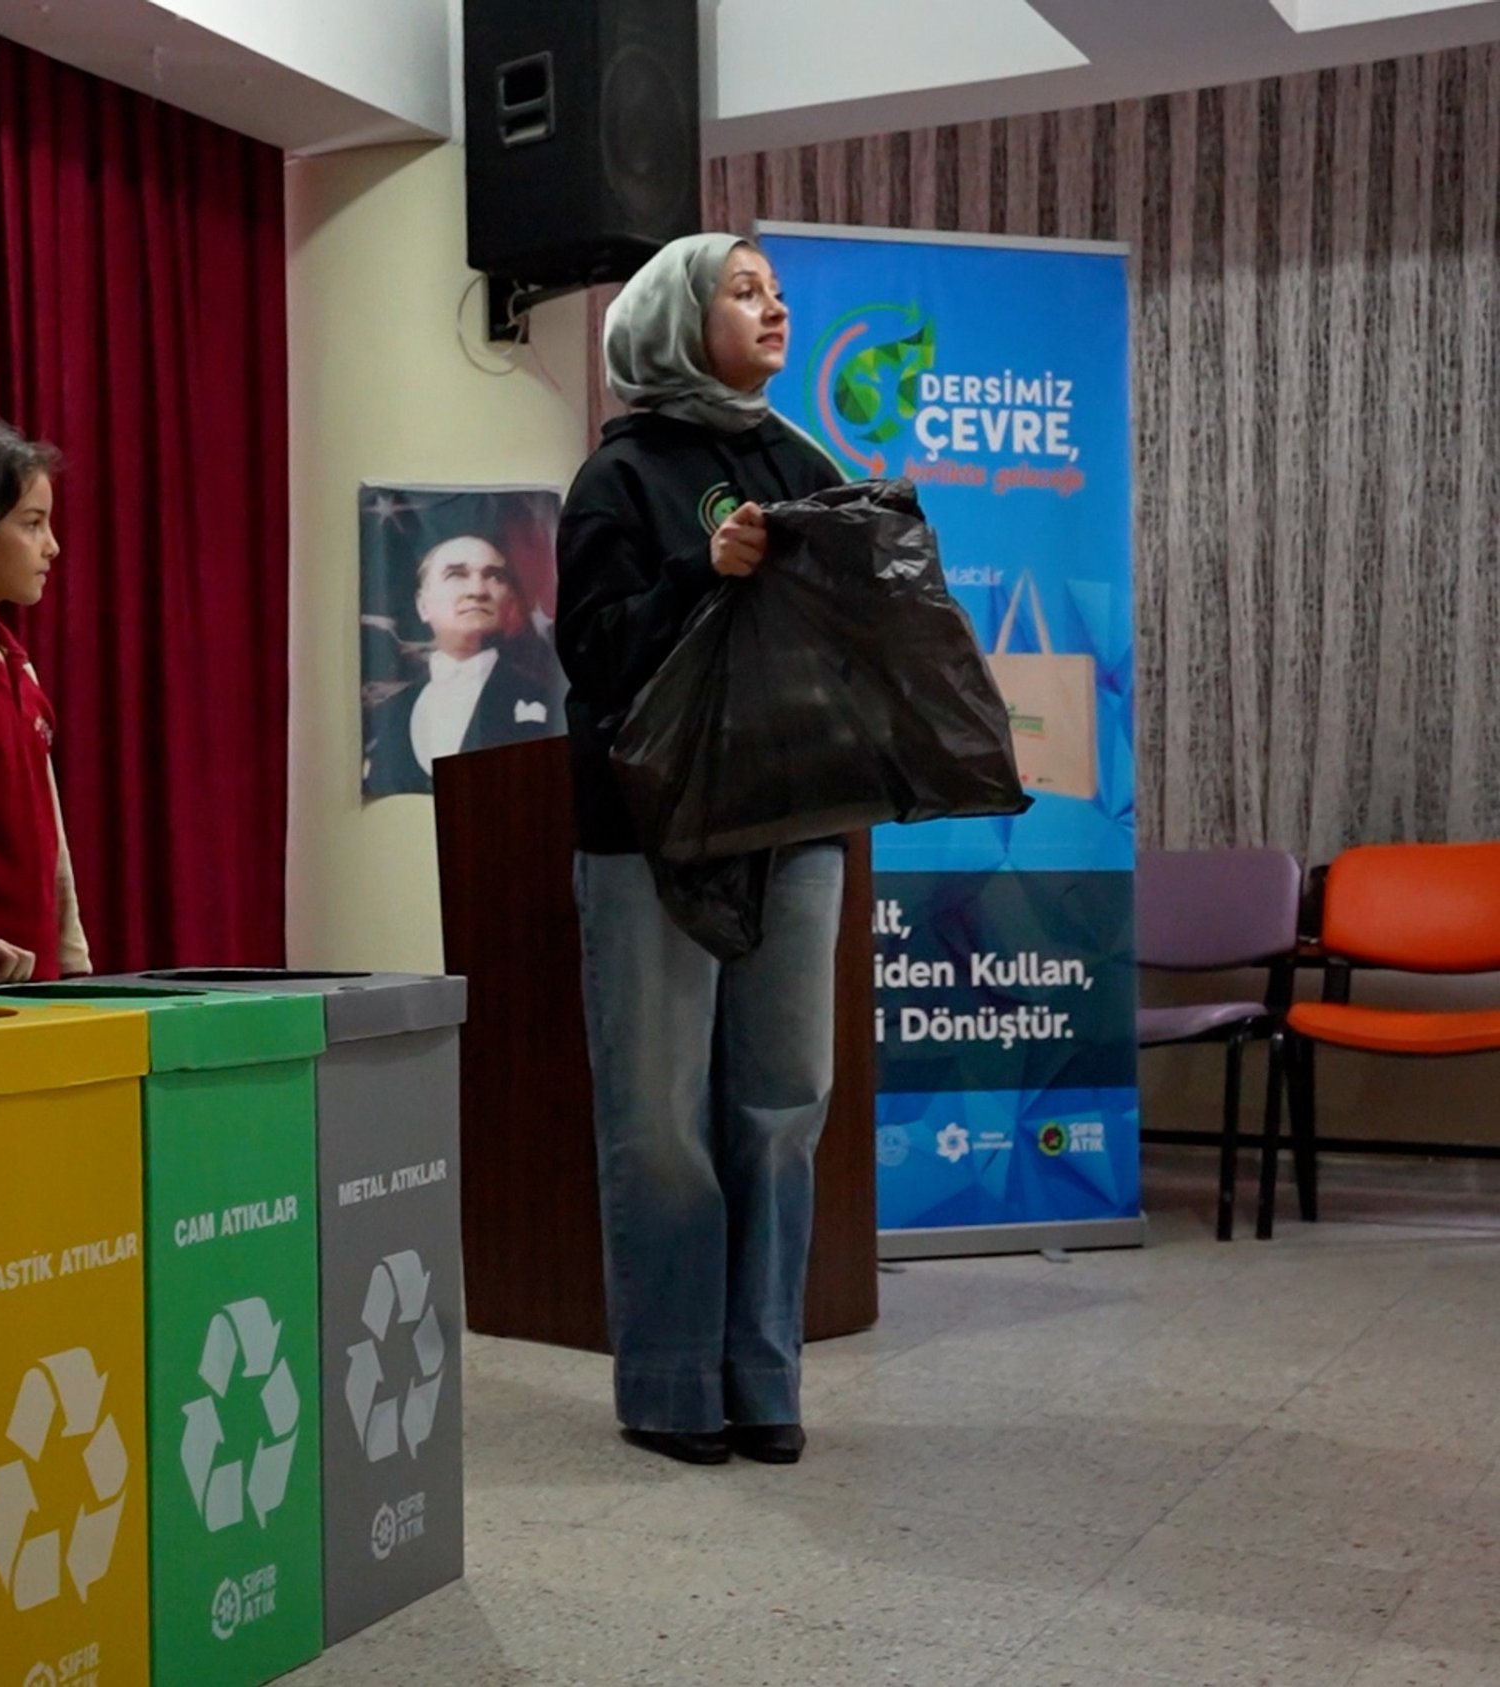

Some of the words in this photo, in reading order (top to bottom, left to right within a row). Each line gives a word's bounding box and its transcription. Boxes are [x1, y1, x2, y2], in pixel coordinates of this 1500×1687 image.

[920, 369, 1074, 408] DERSİMİZ
[915, 405, 1080, 463] ÇEVRE,
[971, 952, 1094, 990] Kullan,
[900, 1005, 1075, 1050] Dönüştür.
[338, 1174, 389, 1206] METAL
[390, 1159, 447, 1193] ATIKLAR
[174, 1212, 216, 1248] CAM
[220, 1195, 298, 1237] ATIKLAR
[59, 1232, 138, 1277] ATIKLAR
